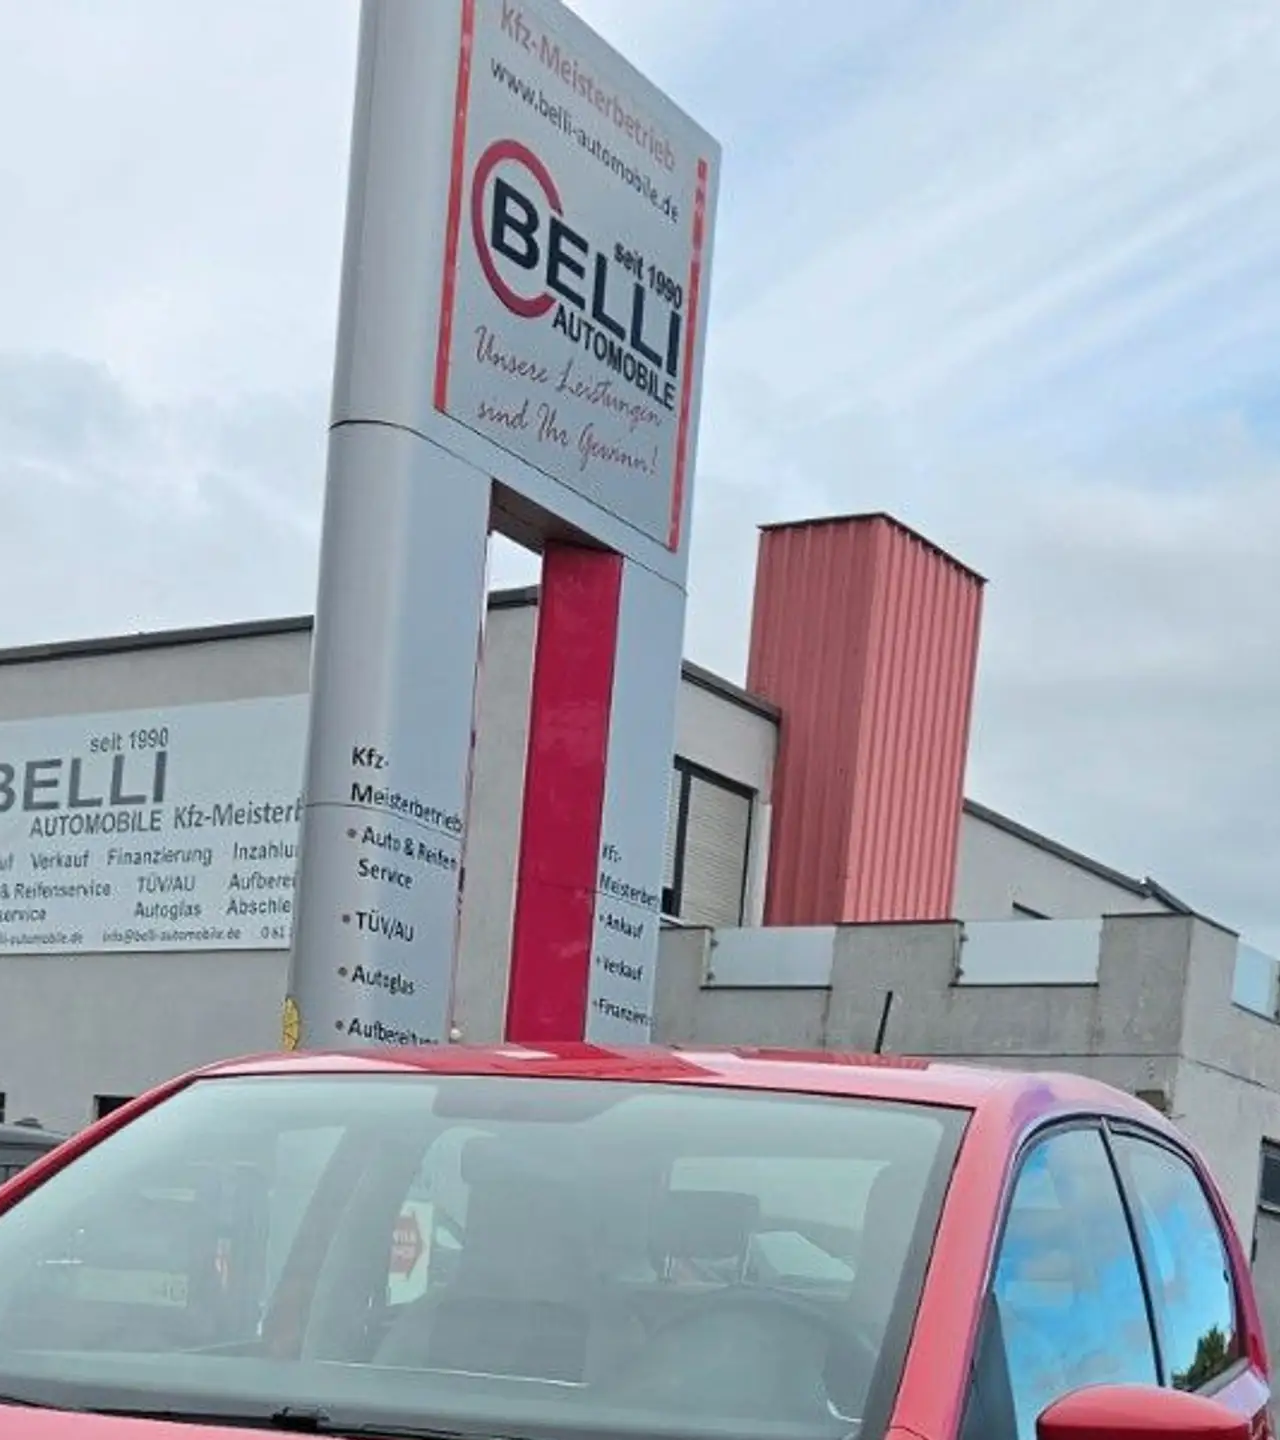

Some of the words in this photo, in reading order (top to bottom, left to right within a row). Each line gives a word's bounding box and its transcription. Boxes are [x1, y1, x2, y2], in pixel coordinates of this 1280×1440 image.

[500, 0, 676, 172] Kfz-Meisterbetrieb
[491, 58, 679, 224] www.belli-automobile.de
[491, 178, 681, 377] BELLI
[614, 241, 645, 283] seit
[647, 263, 684, 311] 1990
[552, 305, 675, 411] AUTOMOBILE
[474, 325, 548, 383] Unsere
[555, 358, 663, 433] Leistungen
[477, 398, 529, 430] sind
[537, 402, 569, 447] Ihr
[90, 732, 123, 753] seit
[128, 727, 169, 750] 1990
[352, 746, 389, 769] Kfz-
[351, 782, 464, 833] Meisterbetrieb
[29, 810, 162, 838] AUTOMOBILE
[361, 826, 401, 851] Auto
[403, 837, 415, 857] &
[30, 850, 89, 870] Verkauf
[107, 846, 213, 866] Finanzierung
[357, 857, 413, 889] Service
[134, 901, 202, 920] Autoglas
[356, 910, 414, 942] TÜV/AU
[606, 914, 644, 939] Ankauf
[351, 964, 415, 995] Autoglas
